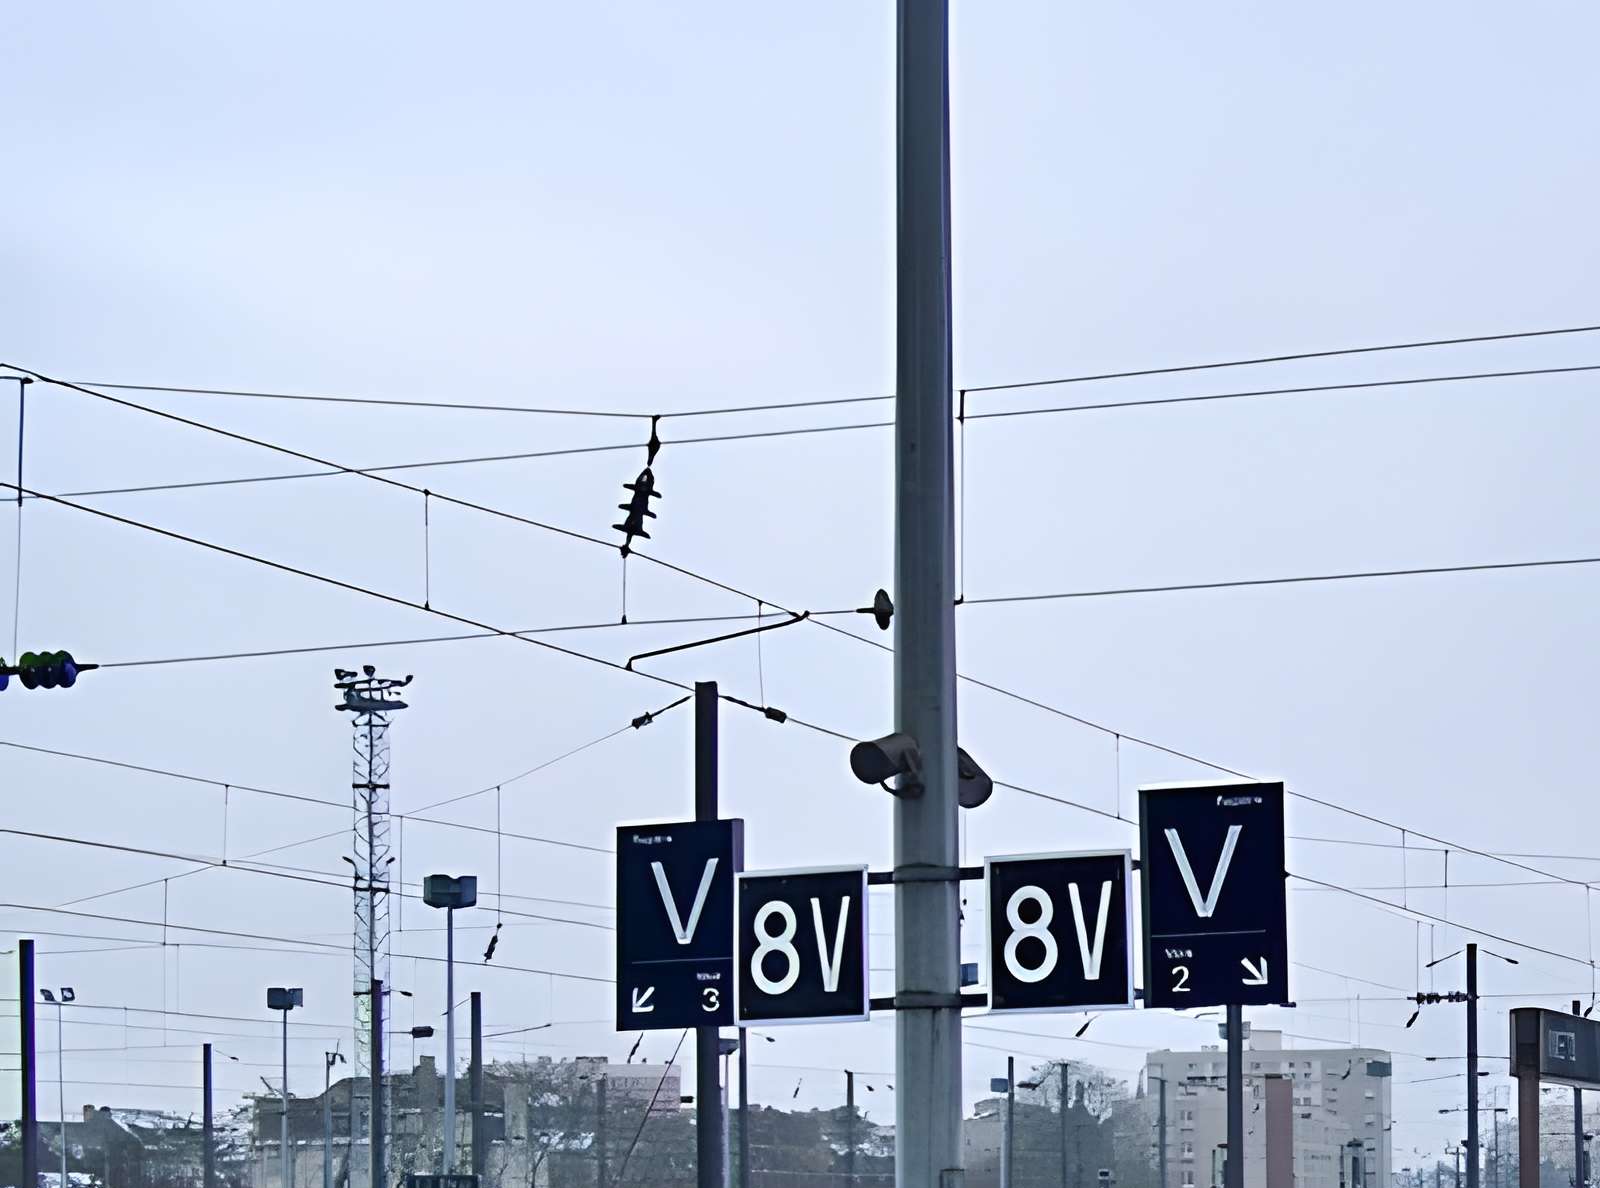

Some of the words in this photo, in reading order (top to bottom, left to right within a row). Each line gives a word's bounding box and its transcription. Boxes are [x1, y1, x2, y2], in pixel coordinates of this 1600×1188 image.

[1164, 825, 1242, 917] V
[651, 857, 719, 945] V
[702, 988, 720, 1012] 3
[1171, 966, 1191, 993] 2
